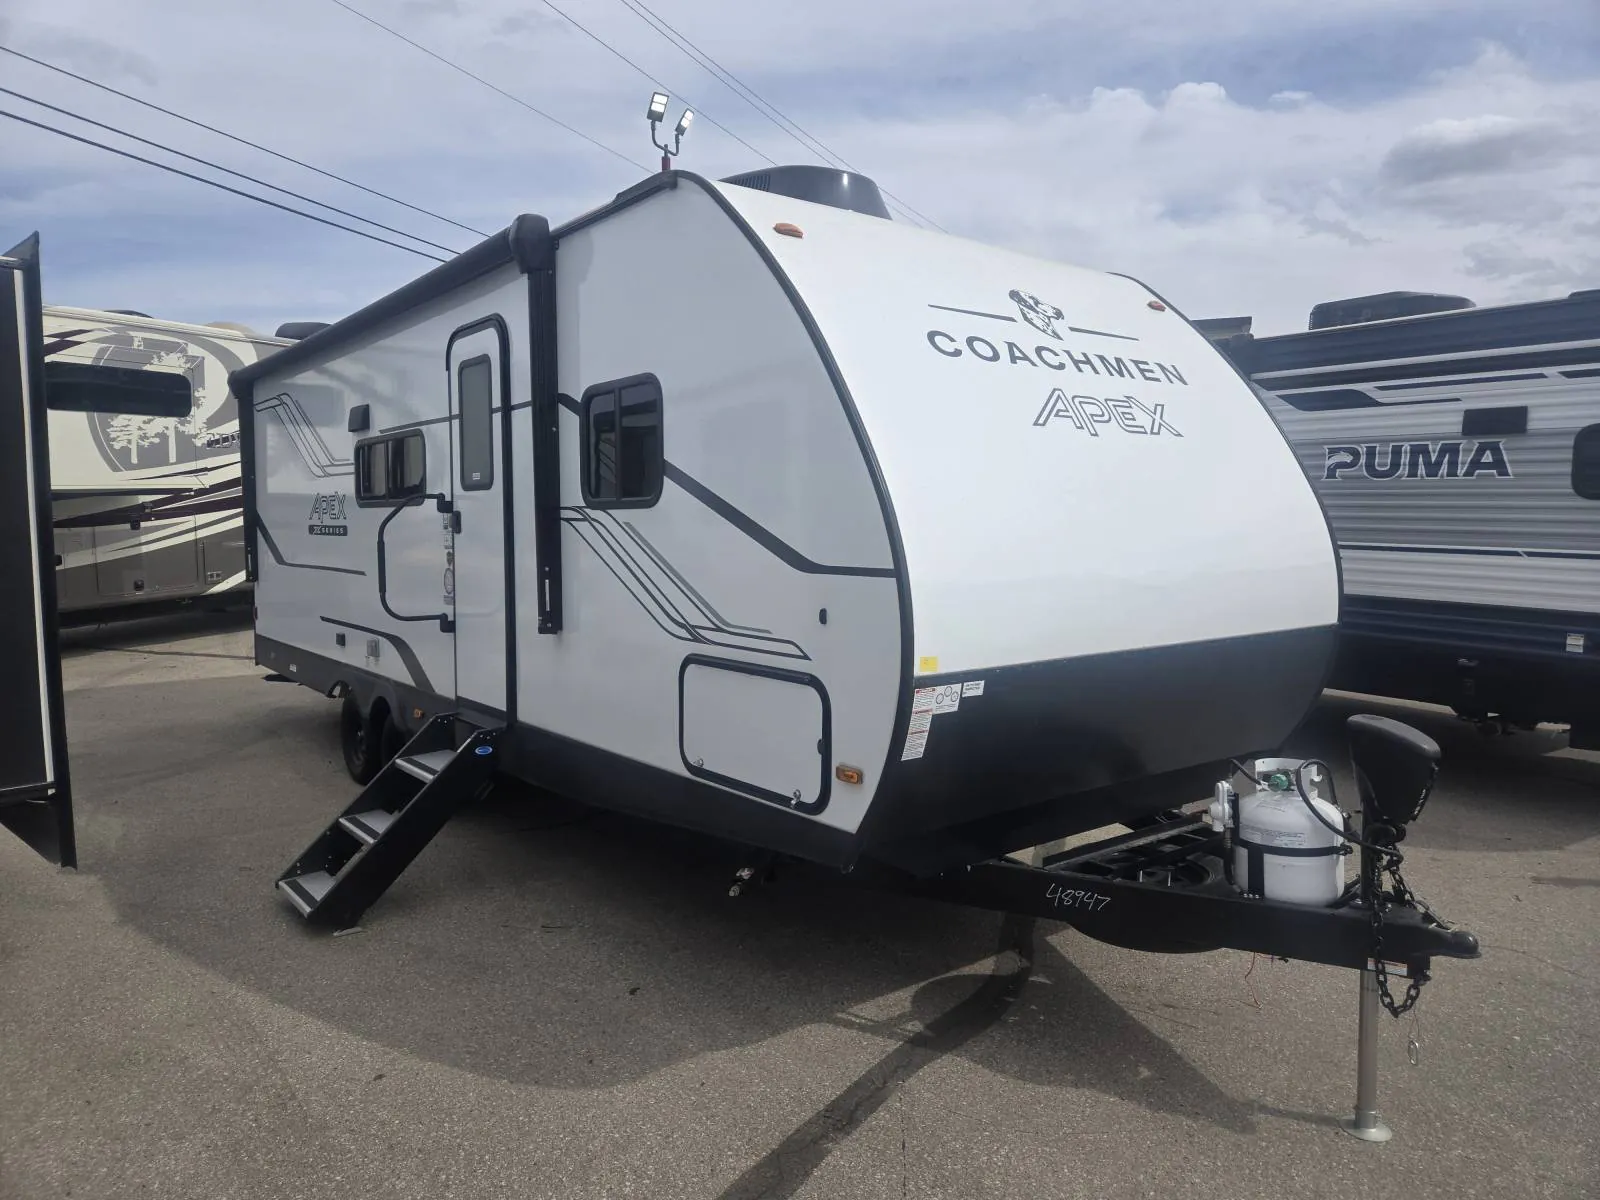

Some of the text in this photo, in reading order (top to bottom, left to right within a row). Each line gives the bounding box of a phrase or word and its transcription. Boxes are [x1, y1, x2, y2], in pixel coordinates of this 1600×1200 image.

[926, 330, 1189, 386] COACHMEN
[1033, 388, 1185, 437] APEX
[1321, 439, 1515, 481] PUMA
[309, 491, 347, 524] APEX
[1045, 883, 1112, 911] 48947
